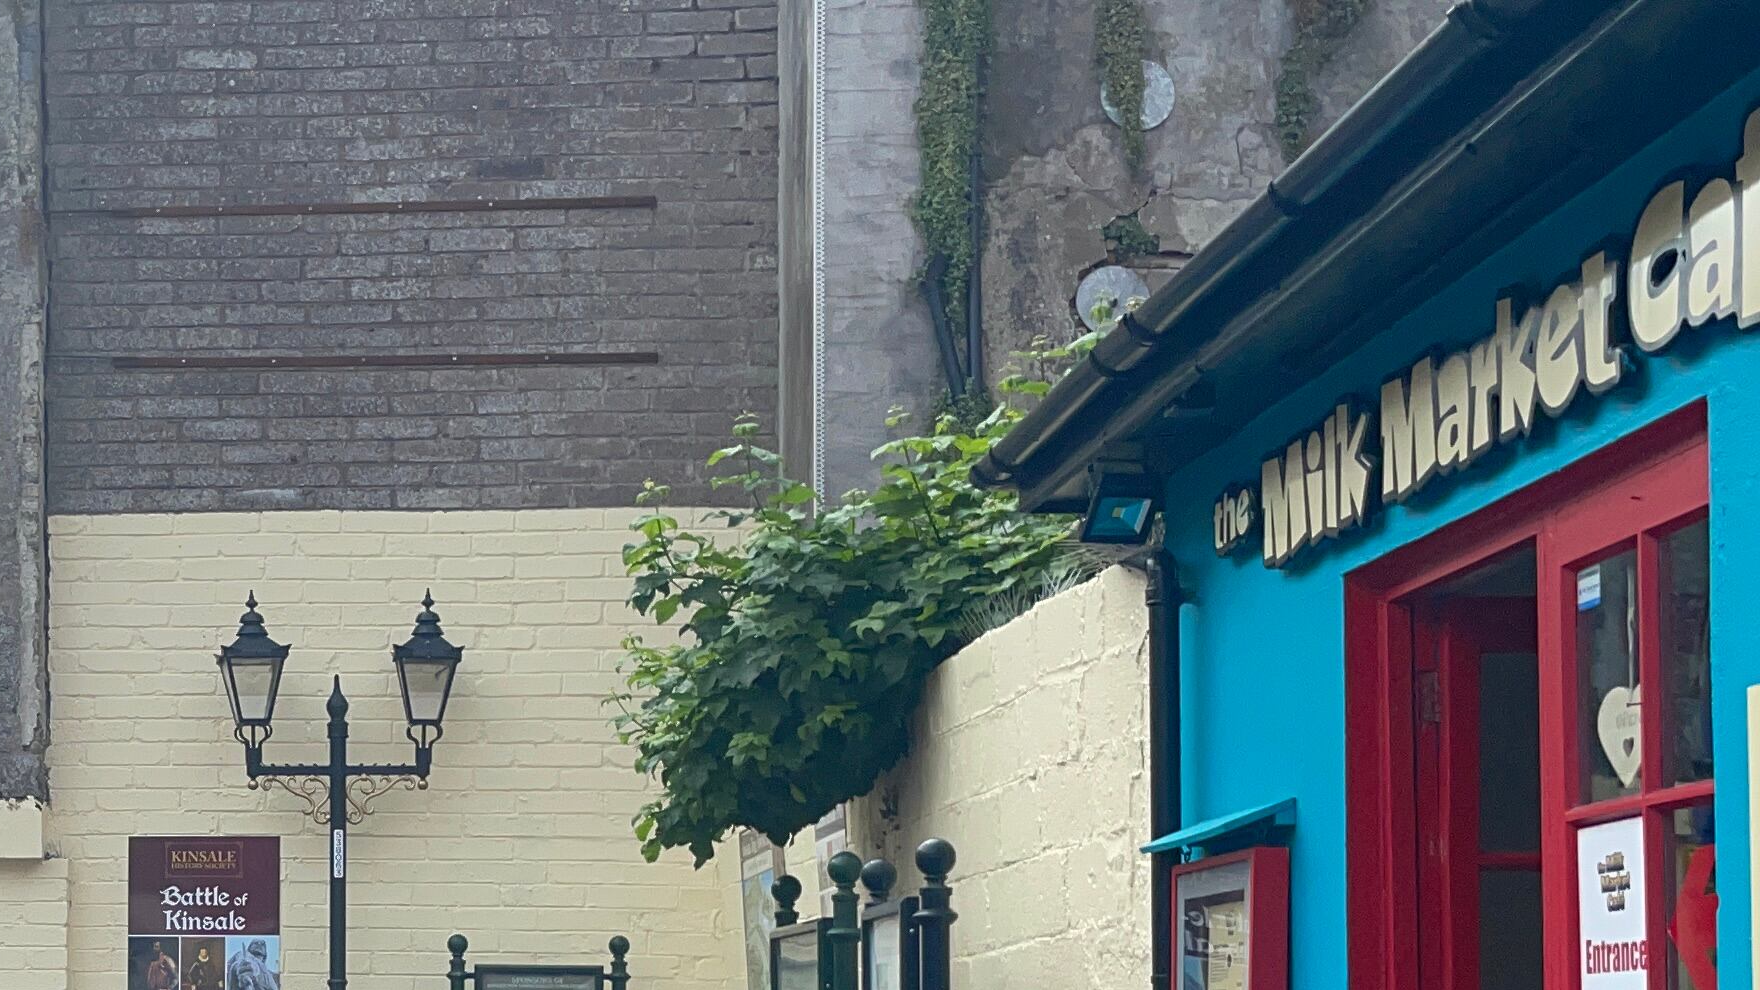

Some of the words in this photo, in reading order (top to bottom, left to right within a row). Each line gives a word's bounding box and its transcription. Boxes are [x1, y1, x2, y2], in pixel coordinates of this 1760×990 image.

[1214, 488, 1252, 551] the
[1262, 404, 1369, 564] Milk
[1381, 251, 1619, 498] Market
[171, 850, 237, 863] KINSALE
[159, 885, 230, 906] Battle
[233, 893, 248, 906] of
[162, 909, 246, 931] Kinsale
[1586, 939, 1649, 975] Entrance
